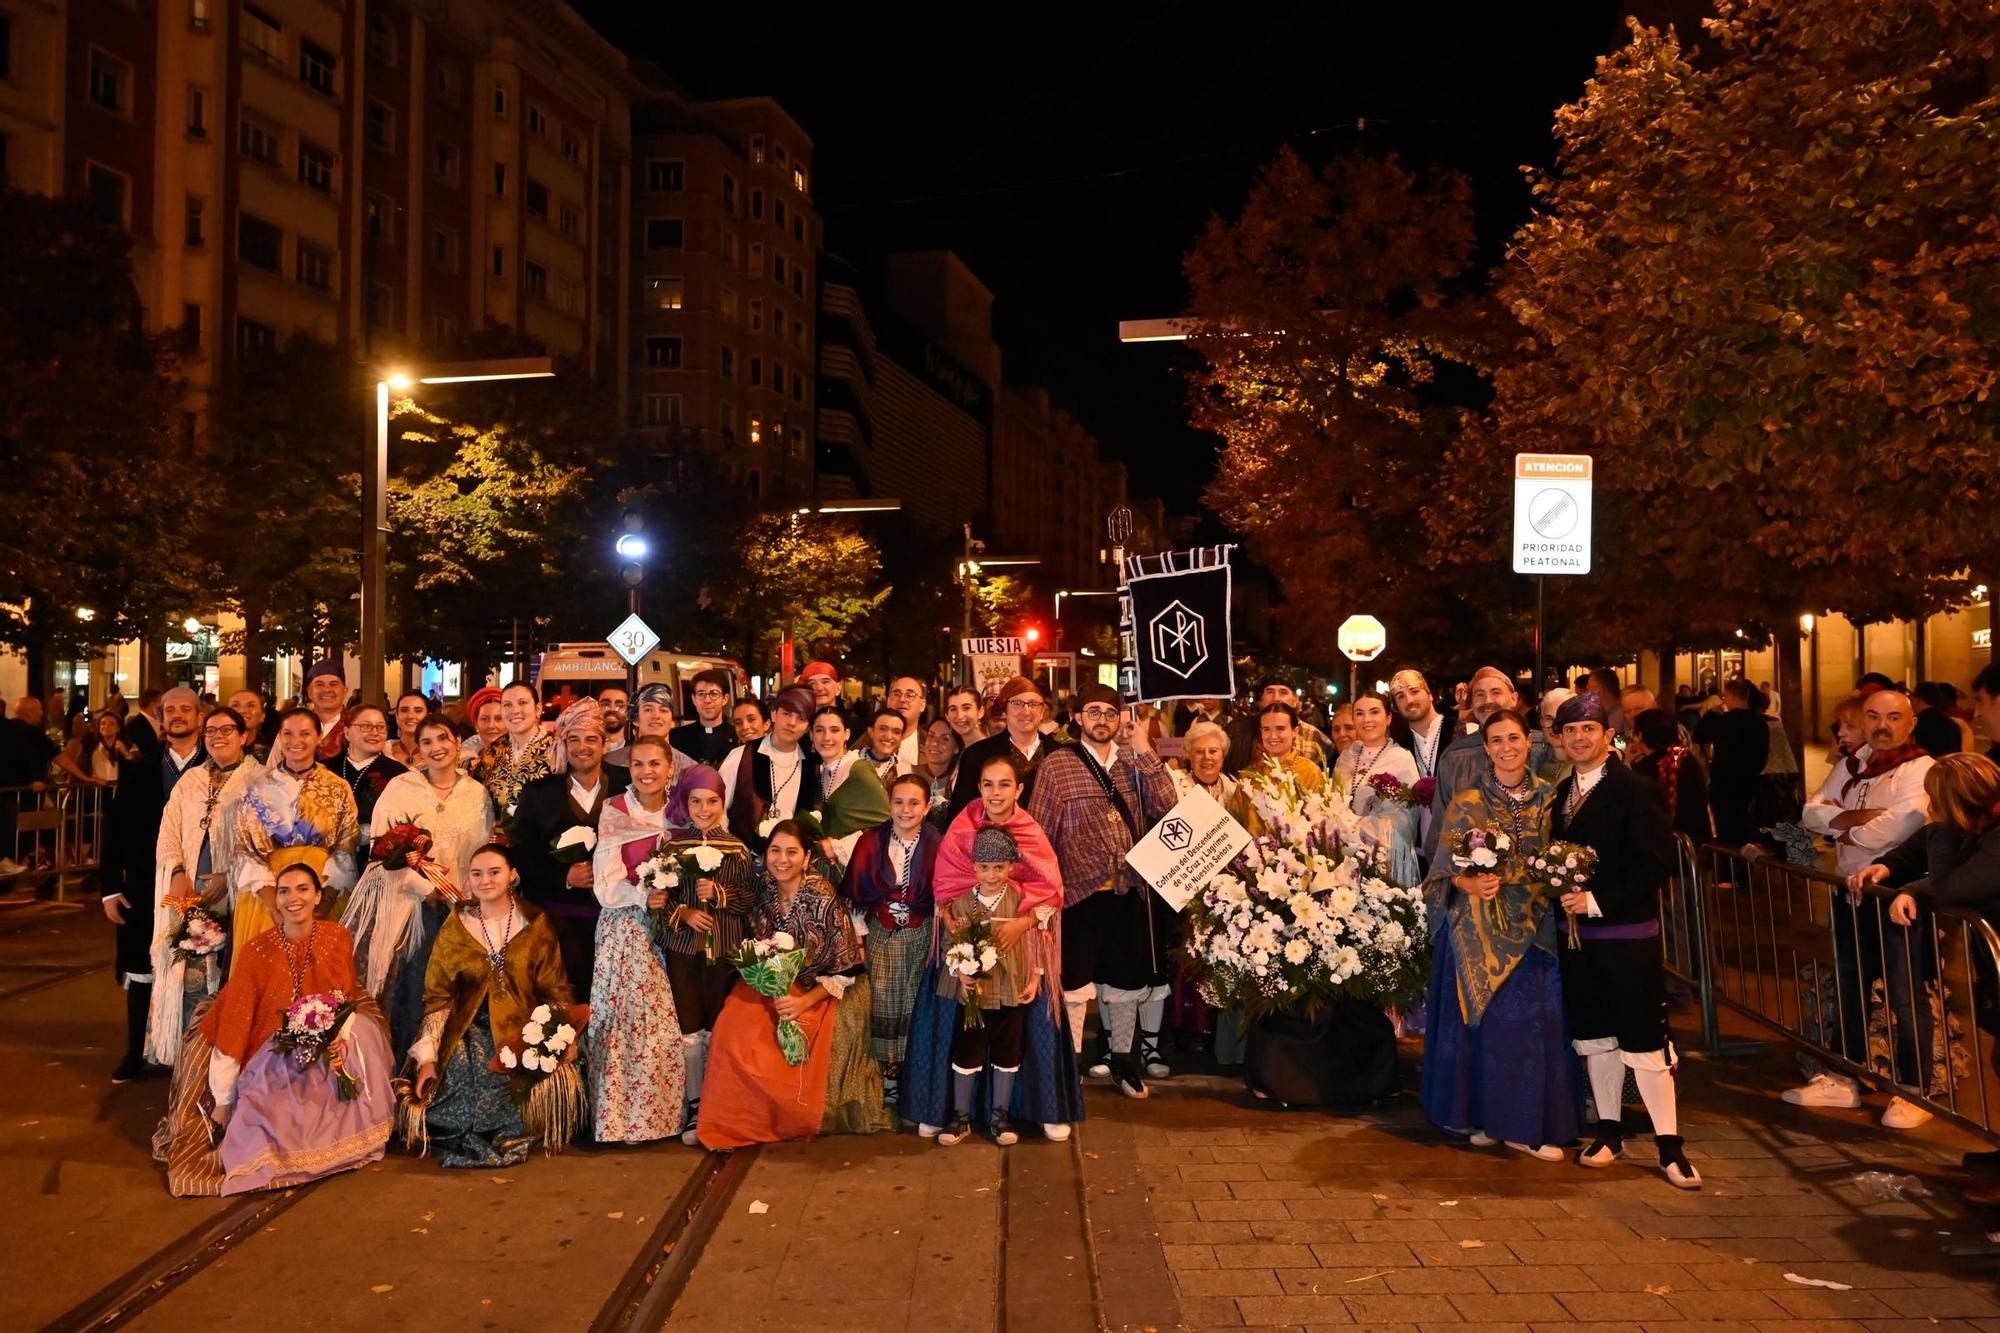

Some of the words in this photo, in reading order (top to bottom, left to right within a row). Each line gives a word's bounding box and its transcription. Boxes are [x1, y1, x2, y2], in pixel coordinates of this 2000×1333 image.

[1522, 543, 1583, 552] PRIORIDAD
[1523, 557, 1582, 567] PEATONAL
[622, 631, 645, 647] 30
[967, 638, 1022, 653] LUESIA
[1178, 854, 1190, 867] del
[1186, 815, 1230, 858] Descendimiento
[1173, 878, 1183, 888] de
[1185, 859, 1201, 874] Cruz
[1184, 882, 1194, 892] de
[1190, 861, 1215, 885] Nuestra
[1211, 843, 1233, 864] Señora
